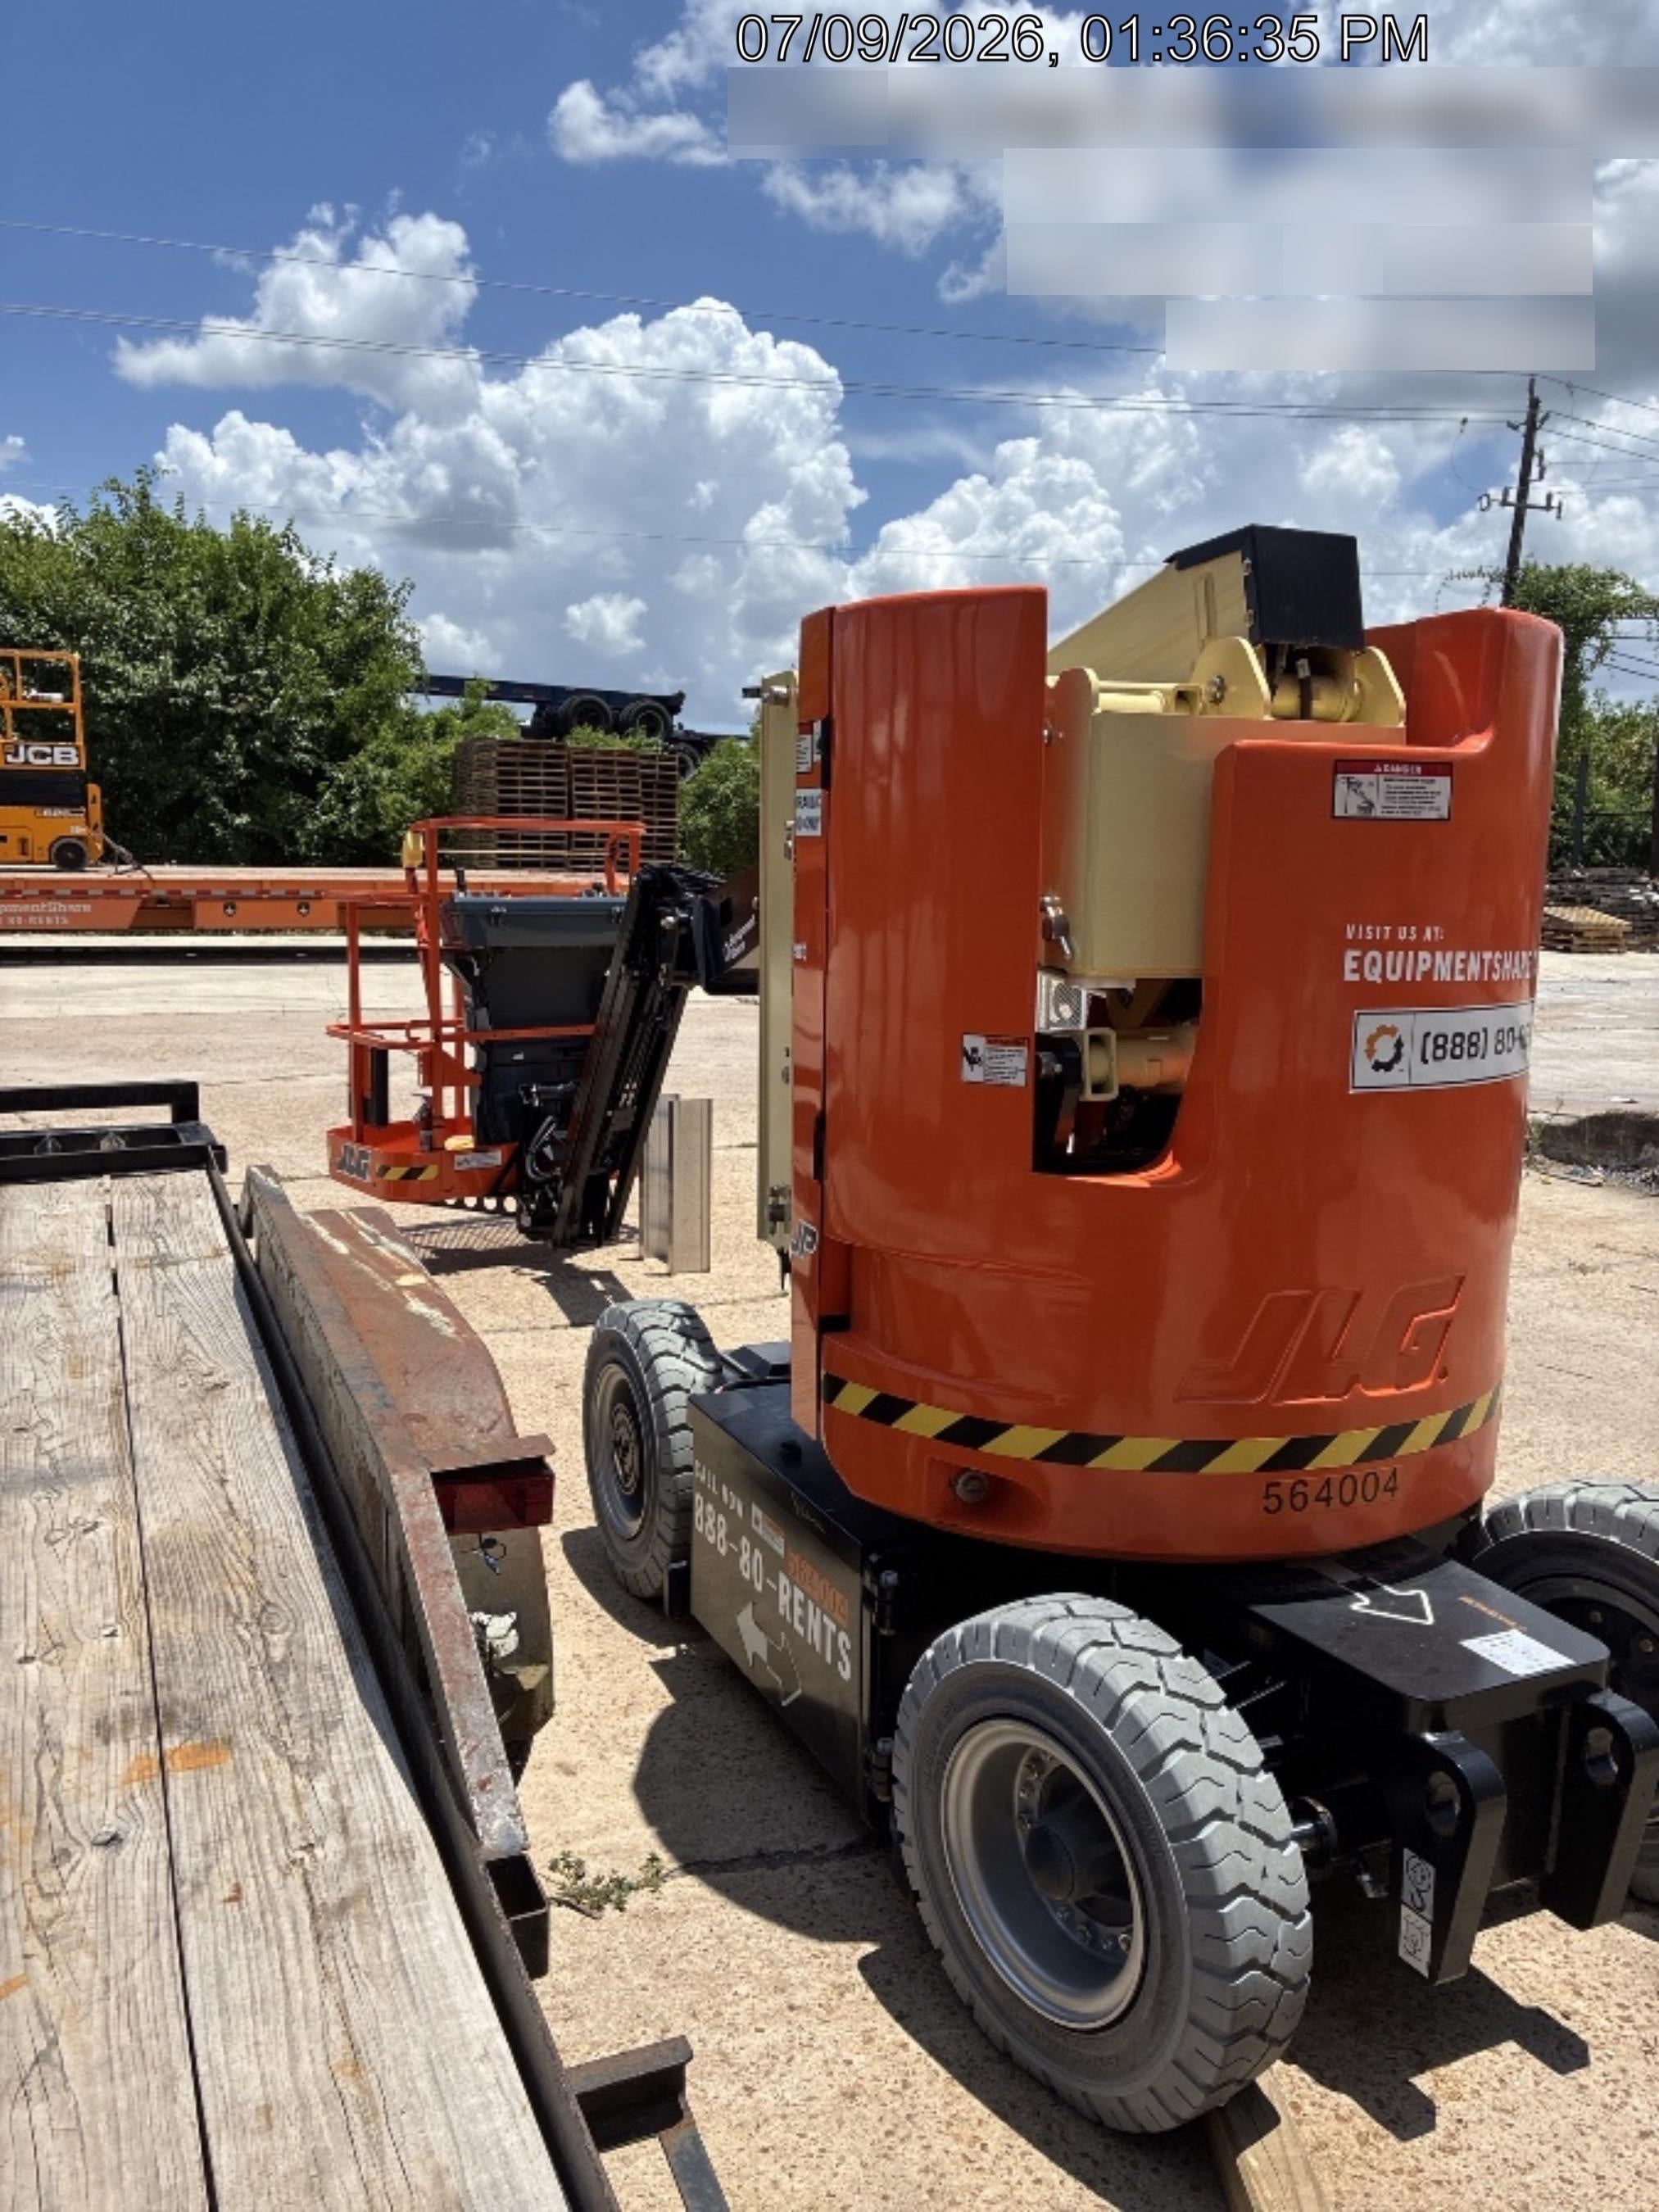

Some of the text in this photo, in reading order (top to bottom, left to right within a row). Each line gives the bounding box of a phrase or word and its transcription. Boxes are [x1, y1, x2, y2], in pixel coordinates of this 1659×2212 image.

[7, 744, 79, 765] JCB
[1346, 924, 1444, 941] VISIT US AT:
[1420, 1027, 1488, 1064] (888)
[1173, 1272, 1466, 1407] JLG
[694, 1459, 744, 1519] CALL NOW
[1262, 1467, 1399, 1515] 564004
